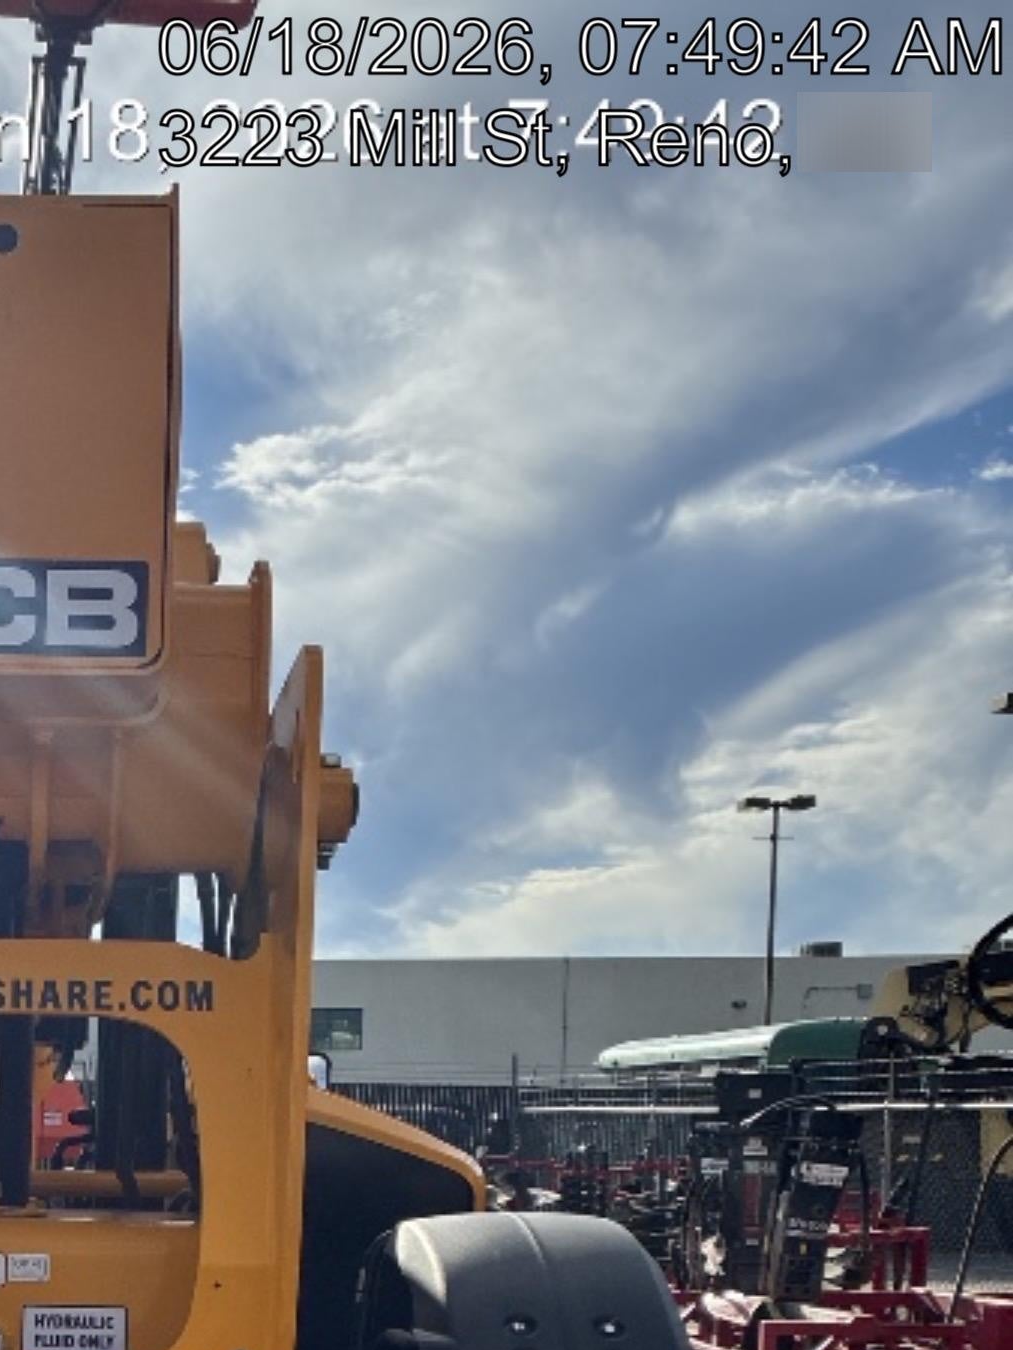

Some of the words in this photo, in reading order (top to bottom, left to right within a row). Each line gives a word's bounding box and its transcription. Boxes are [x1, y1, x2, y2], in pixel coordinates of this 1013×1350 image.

[34, 1313, 115, 1330] HYDRAULIC
[34, 1334, 75, 1348] FLUID
[79, 1334, 115, 1350] ONLY
